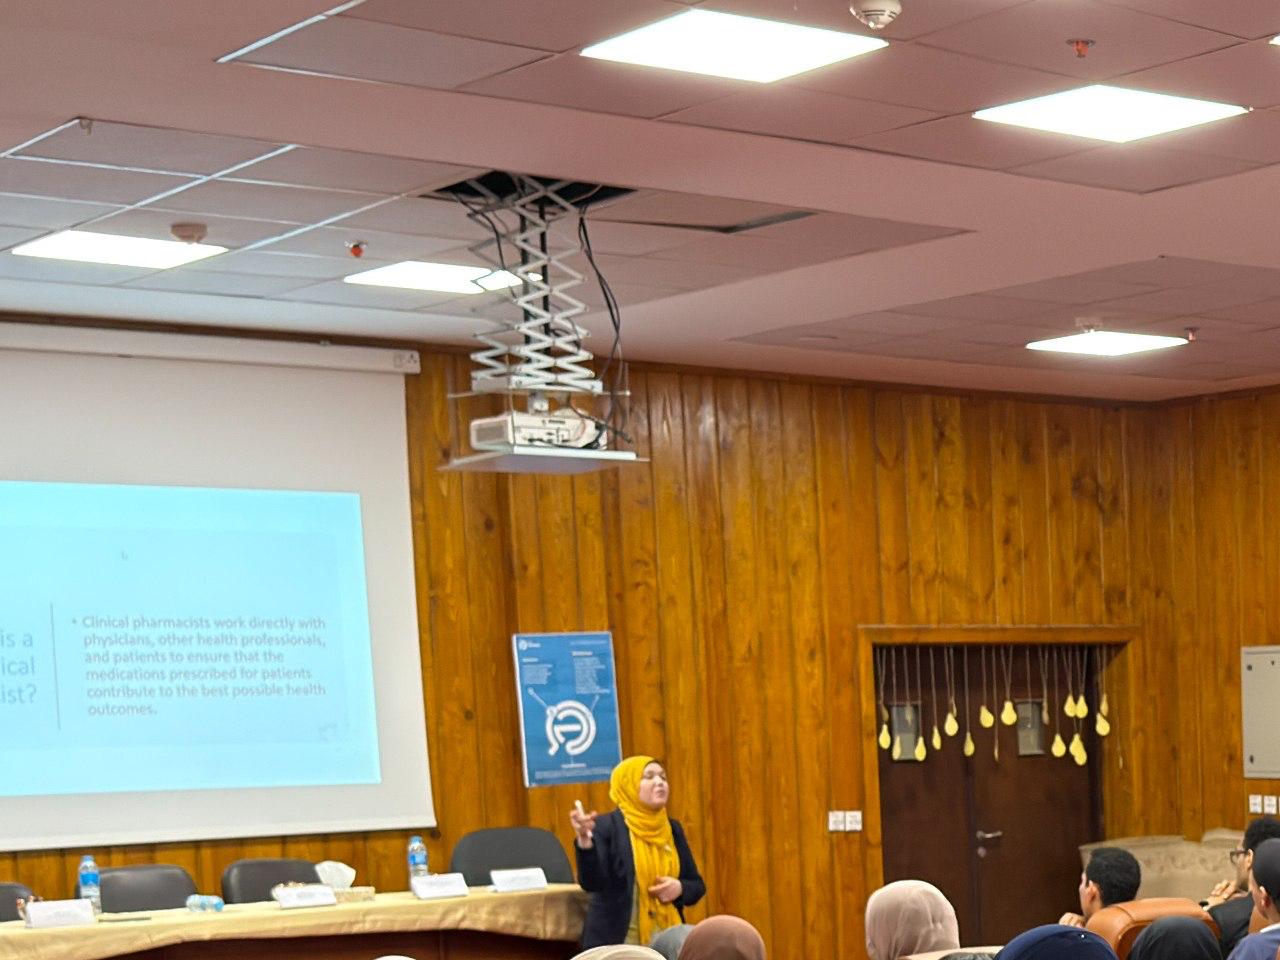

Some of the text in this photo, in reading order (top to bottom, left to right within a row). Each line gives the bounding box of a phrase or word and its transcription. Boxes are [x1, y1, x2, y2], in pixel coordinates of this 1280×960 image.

[82, 616, 326, 632] Clinical pharmacists work directly with
[22, 633, 34, 648] a
[84, 633, 326, 648] physicians, other health professionals,
[85, 650, 284, 665] and patients to ensure that the
[86, 667, 312, 682] medications prescribed for patients
[87, 684, 326, 699] contribute to the best possible health
[88, 703, 158, 716] outcomes.
